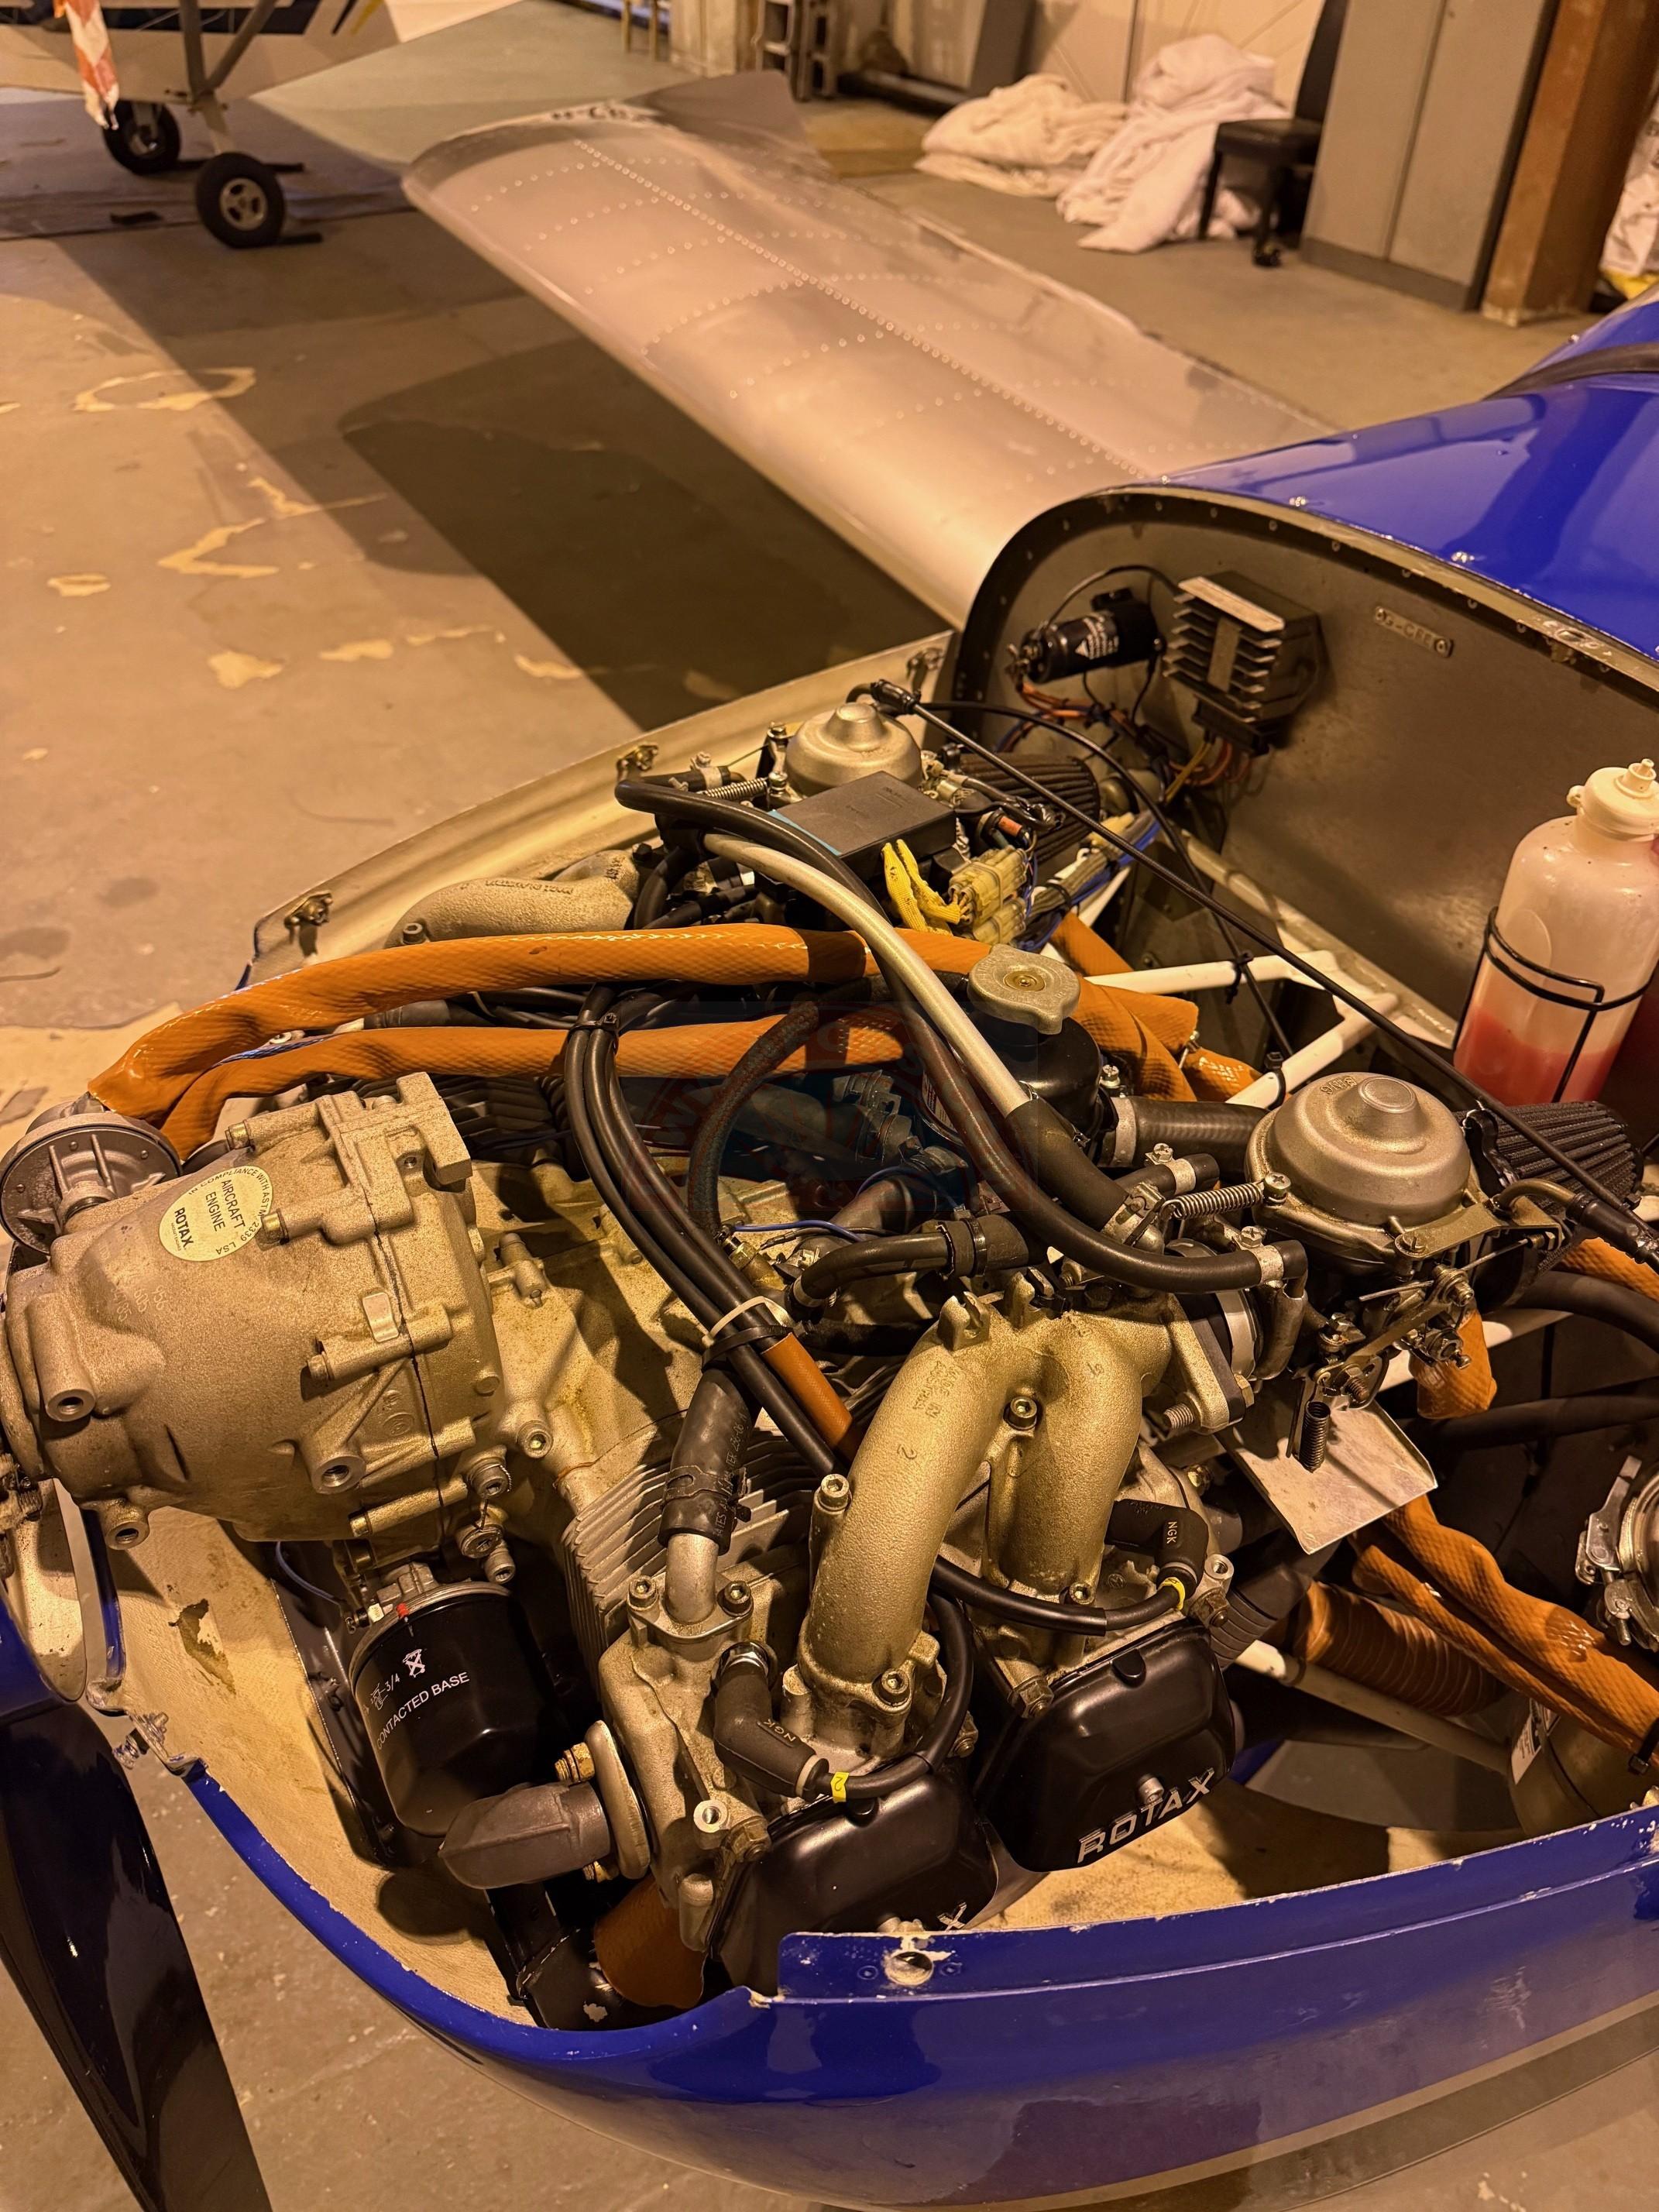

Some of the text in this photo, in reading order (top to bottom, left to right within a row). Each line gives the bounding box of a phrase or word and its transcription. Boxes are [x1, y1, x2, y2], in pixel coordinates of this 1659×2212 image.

[200, 1167, 257, 1188] COMPLIANCE
[256, 1171, 270, 1192] WITH
[205, 1190, 226, 1232] ENGINE
[222, 1178, 246, 1229] AIRCRAFT
[174, 1206, 194, 1249] ROTAX
[215, 1241, 237, 1255] LSA
[1166, 1521, 1178, 1544] NGK
[376, 1671, 471, 1751] CONTACTED BASE
[763, 1719, 797, 1742] NGK
[834, 1776, 843, 1791] 2
[1077, 1767, 1215, 1864] ROTAX
